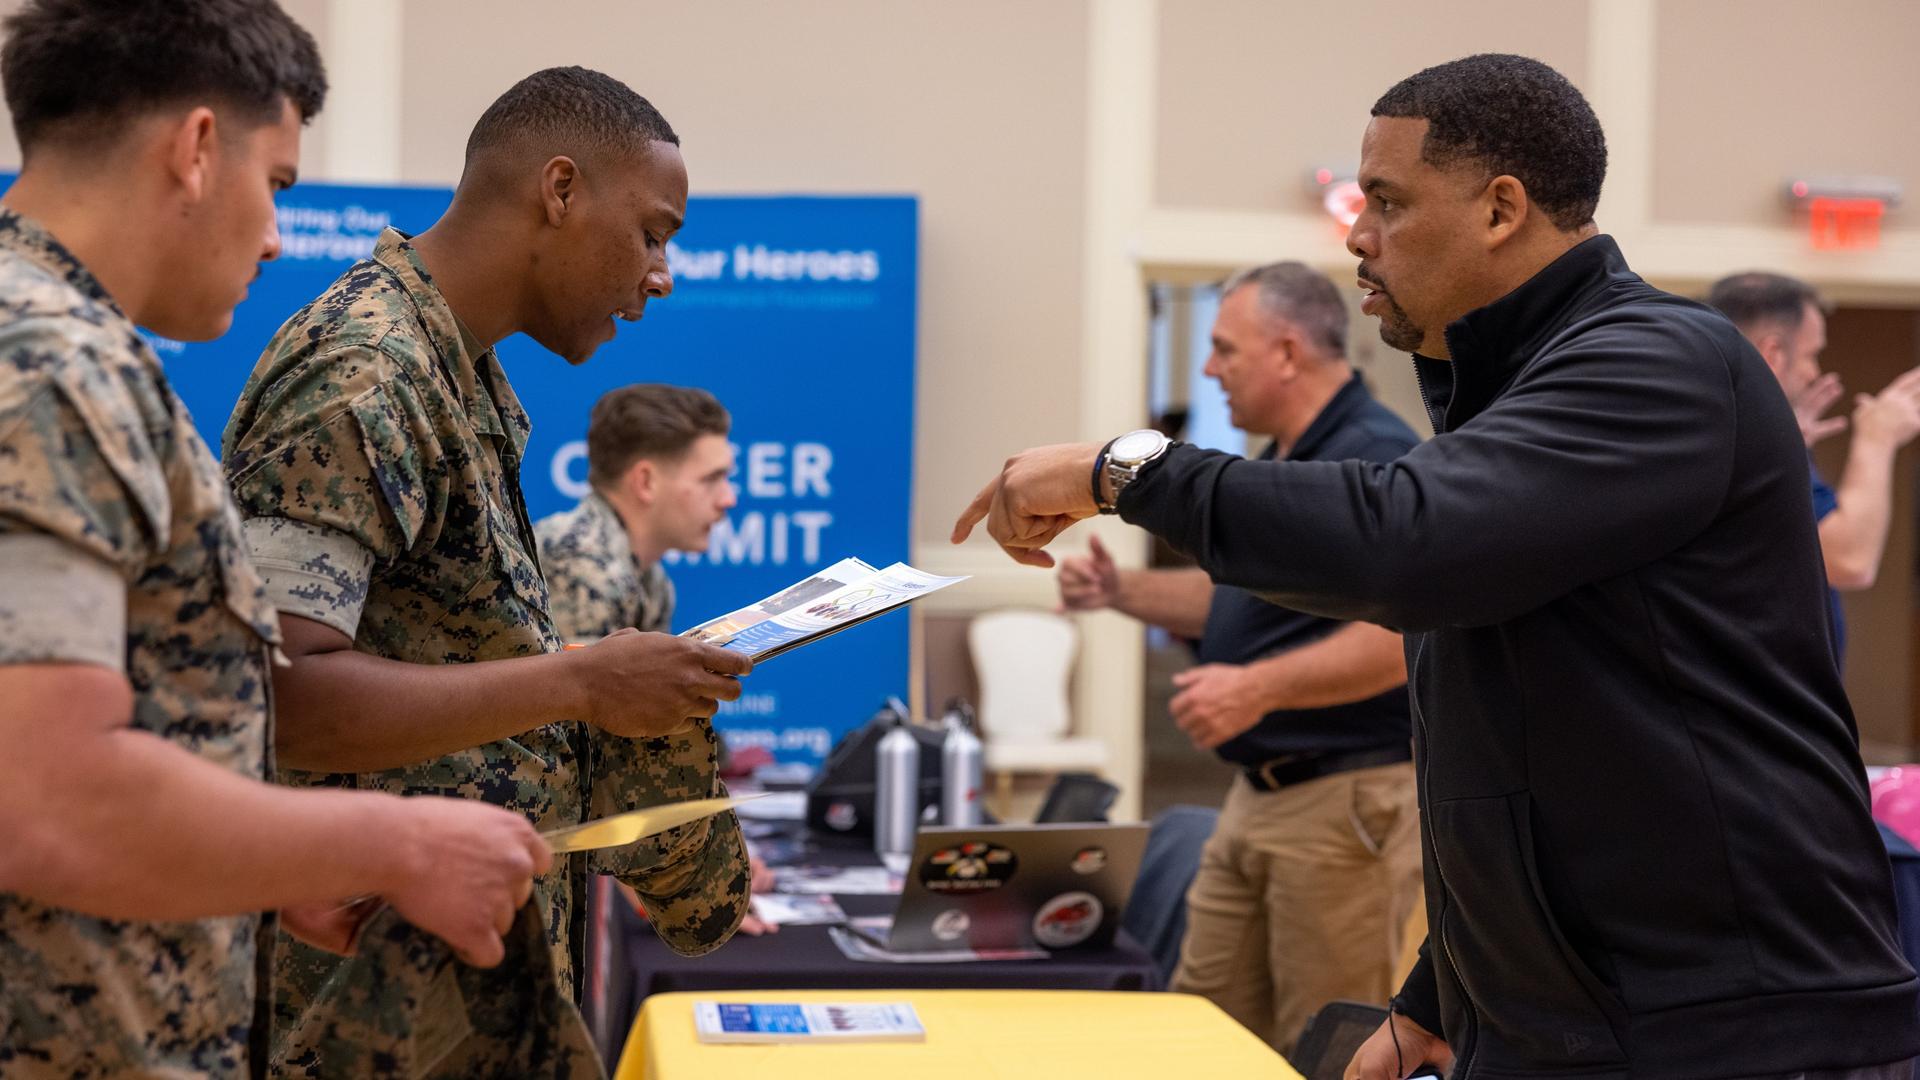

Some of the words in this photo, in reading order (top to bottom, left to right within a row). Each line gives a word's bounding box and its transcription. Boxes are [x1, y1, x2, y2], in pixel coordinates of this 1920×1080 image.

[733, 245, 880, 281] Heroes
[550, 441, 833, 499] CER
[664, 510, 833, 565] MIT
